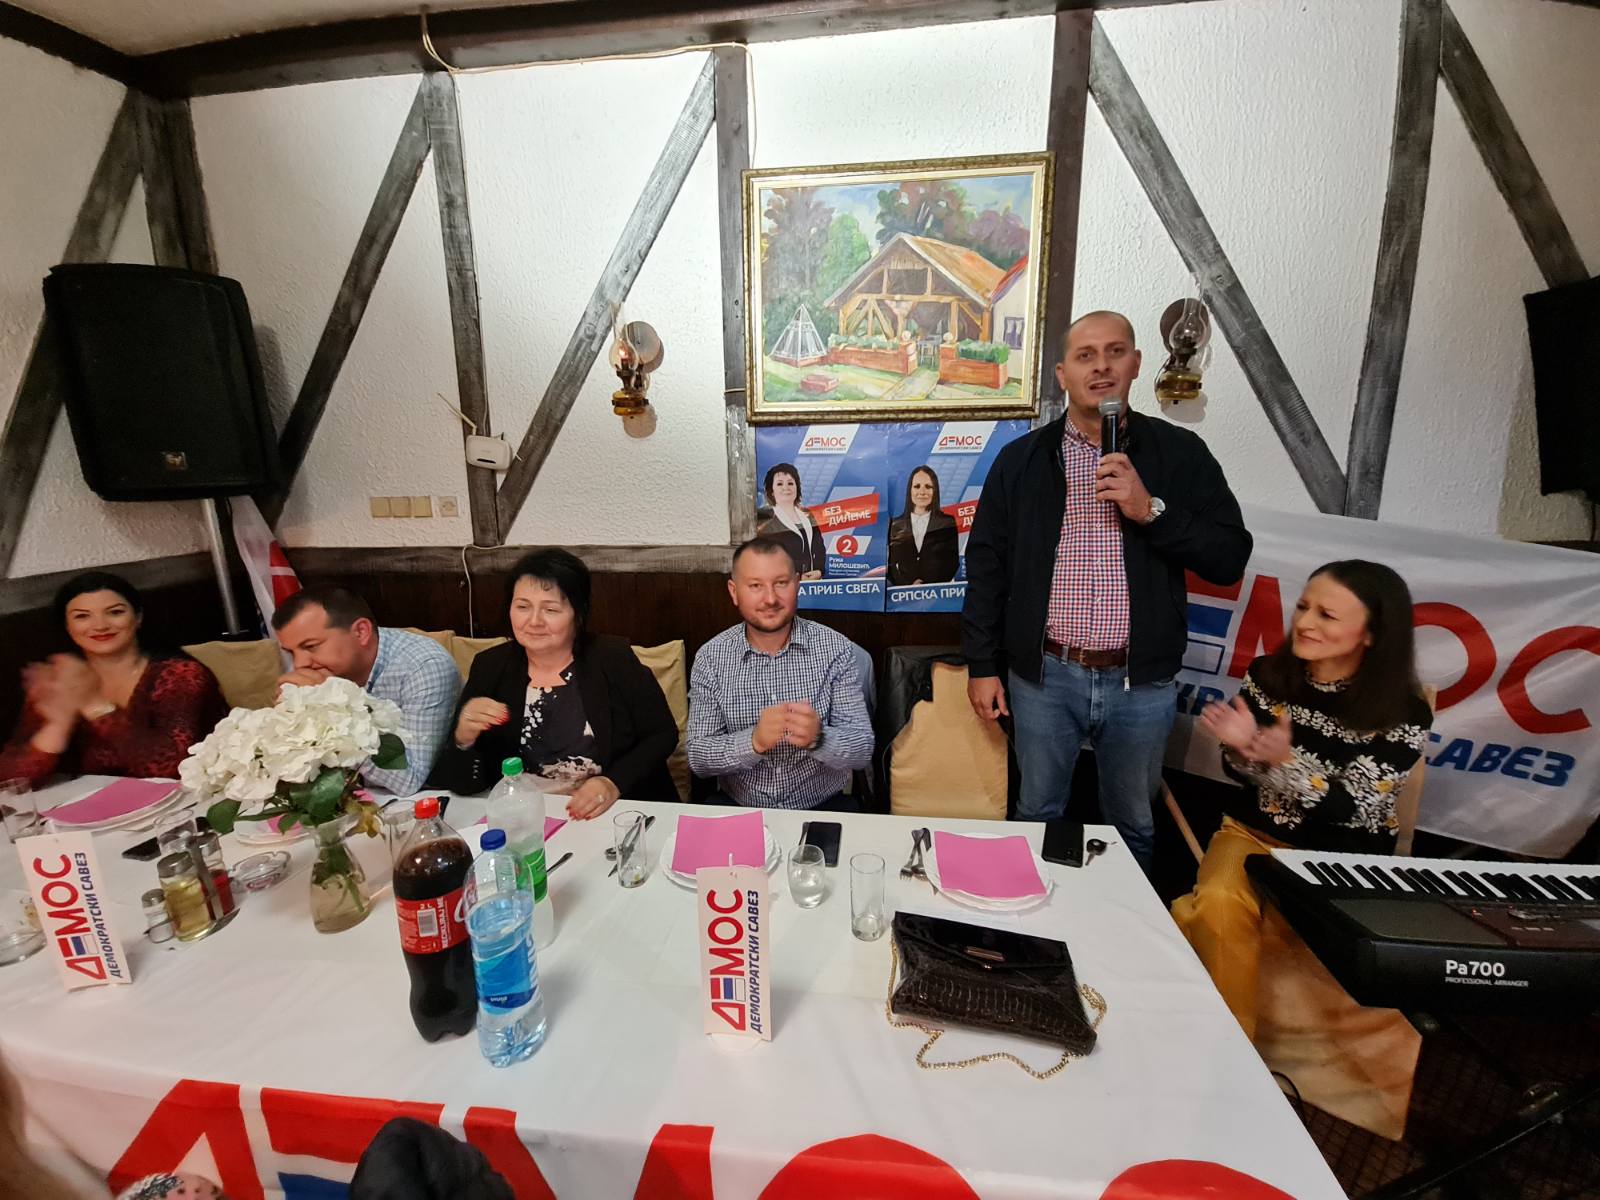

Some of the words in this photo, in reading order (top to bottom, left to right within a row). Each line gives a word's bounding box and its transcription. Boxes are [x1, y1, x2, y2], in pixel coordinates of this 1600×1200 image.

[823, 506, 841, 516] БЕЗ
[828, 510, 871, 527] ДИЛЕМЕ
[957, 506, 976, 517] БЕЗ
[842, 539, 852, 553] 2
[808, 584, 843, 596] ПРИЈЕ
[845, 582, 880, 594] СВЕГА
[890, 588, 937, 602] СРПСКА
[940, 586, 966, 599] ПРИ
[74, 852, 94, 892] САВЕЗ
[747, 890, 759, 935] САВЕЗ
[85, 893, 123, 979] ДЕМОКРАТСКИ
[1446, 959, 1506, 977] Pa700
[749, 935, 762, 1034] ДЕМОКРАТСКИ
[1445, 976, 1493, 986] PROFESSIONAL
[1493, 979, 1529, 988] ARRANGER
